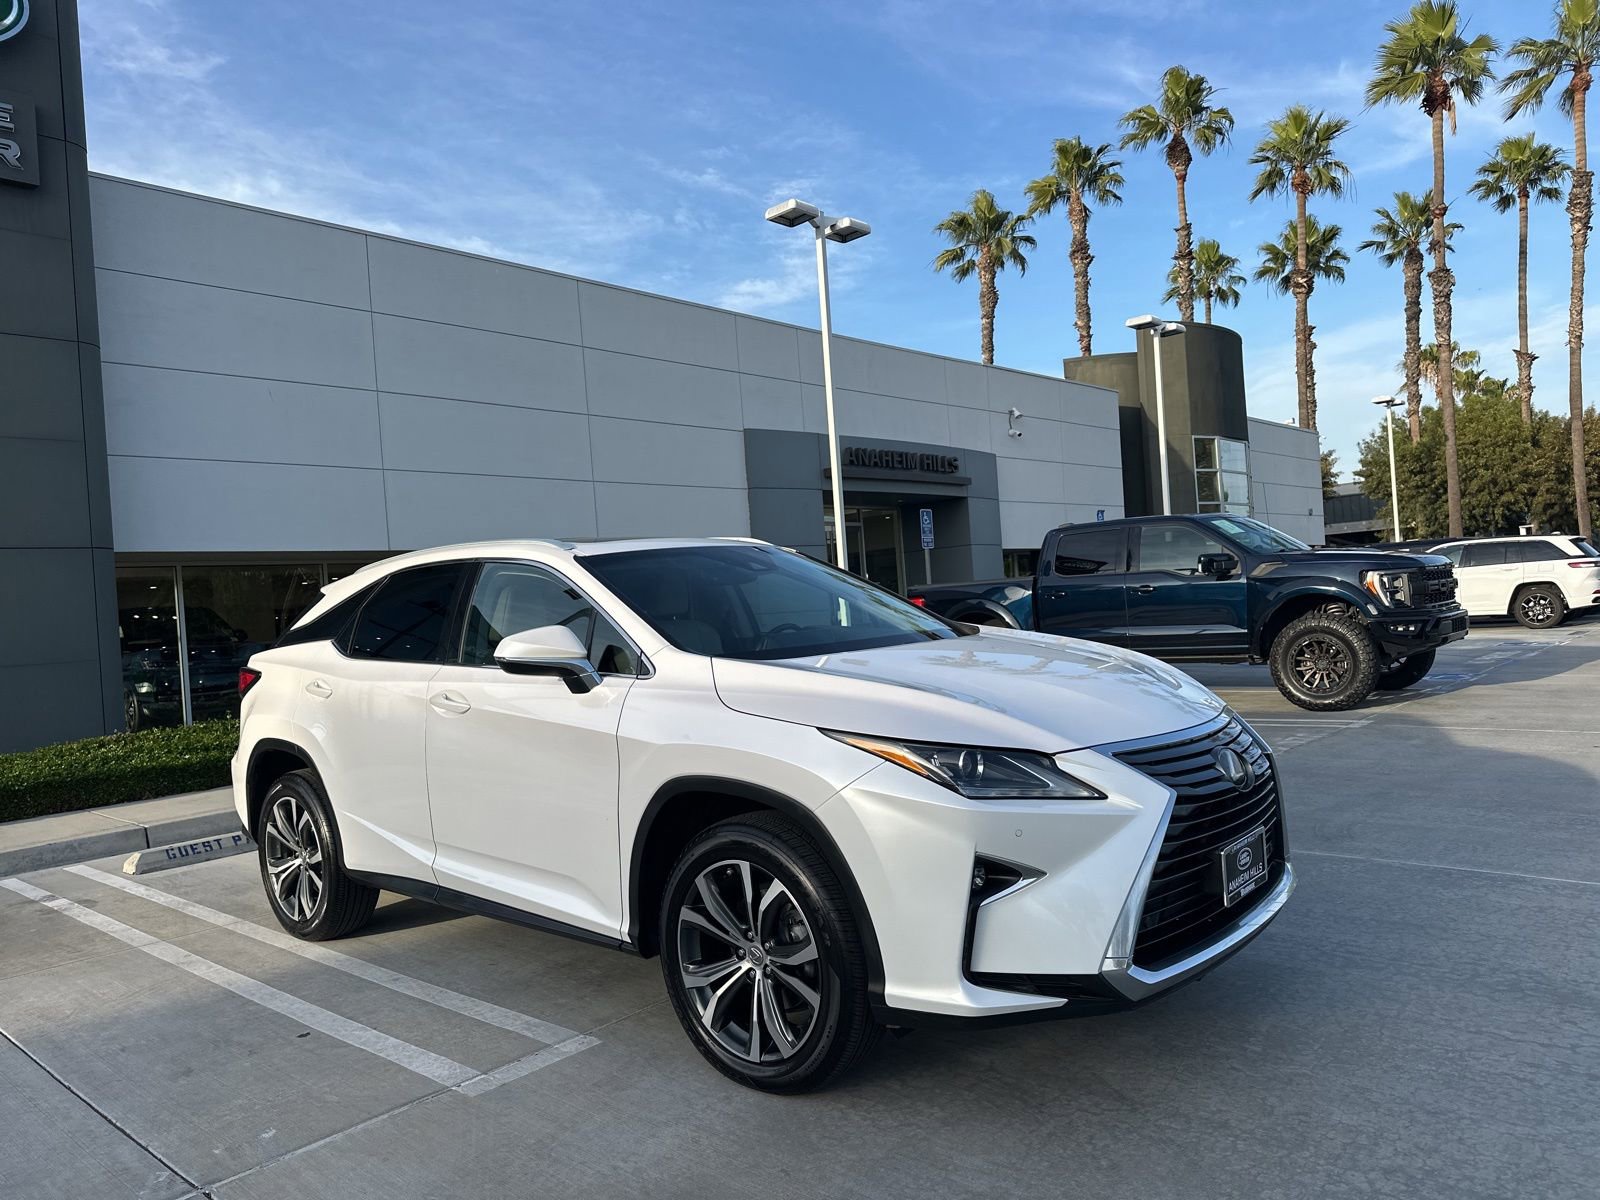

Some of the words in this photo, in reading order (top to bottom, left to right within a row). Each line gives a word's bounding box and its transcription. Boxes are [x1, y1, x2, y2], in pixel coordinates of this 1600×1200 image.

[845, 447, 920, 470] ANAHEIM
[923, 454, 960, 474] HILLS
[166, 838, 223, 860] GUEST
[1228, 870, 1250, 893] ANAHEIM
[1249, 862, 1263, 878] HILLS
